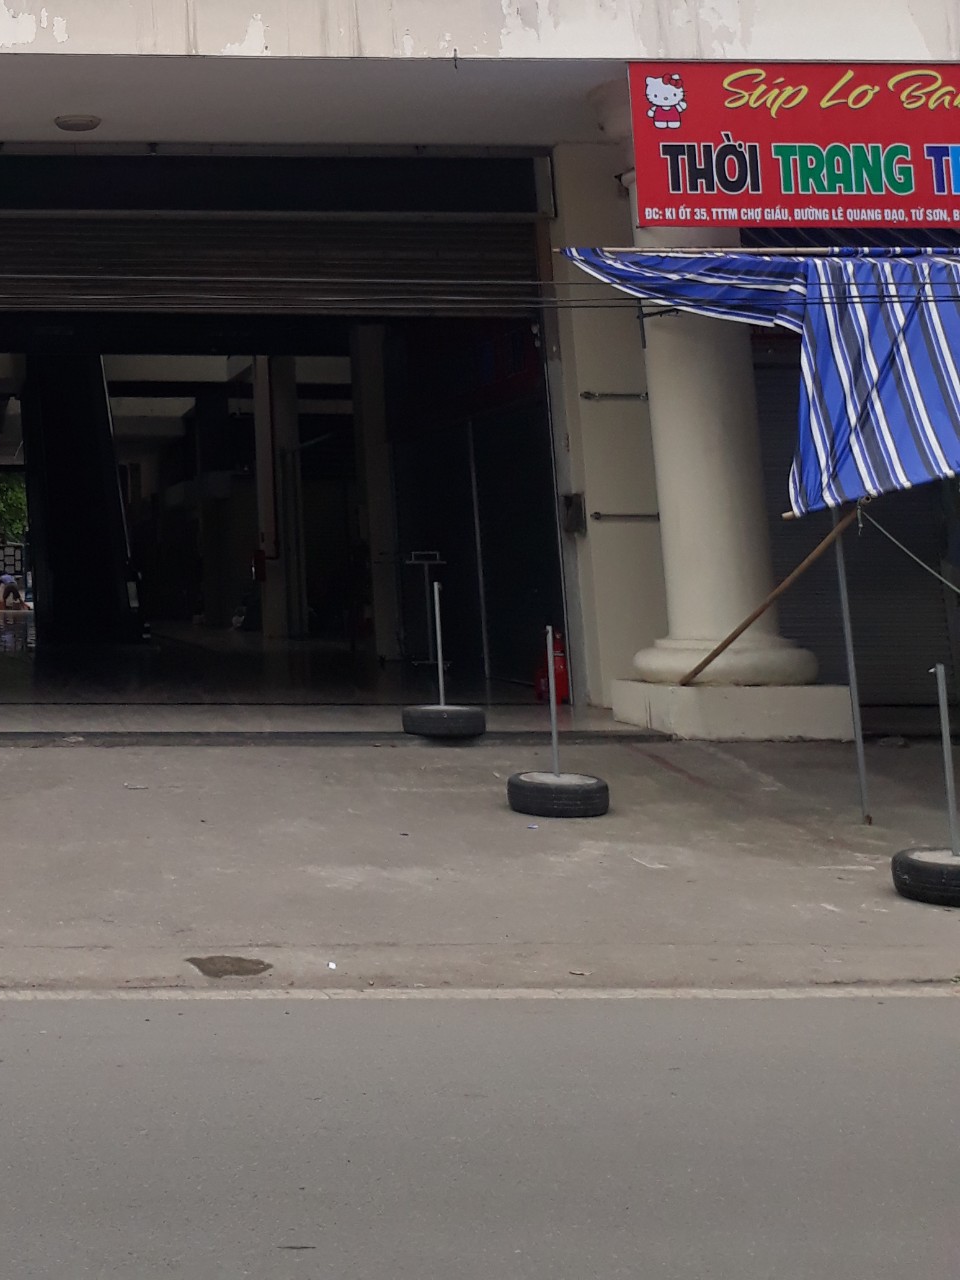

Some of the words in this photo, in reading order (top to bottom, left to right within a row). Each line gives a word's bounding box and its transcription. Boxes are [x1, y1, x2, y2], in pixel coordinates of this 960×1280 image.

[722, 68, 809, 118] Súp
[819, 69, 880, 109] Lơ
[660, 131, 762, 194] THỜI
[772, 143, 914, 195] TRANG
[644, 207, 663, 219] ĐC:
[664, 207, 677, 219] KI
[694, 207, 710, 221] 35,
[711, 207, 739, 220] TTTM
[740, 207, 763, 223] CHỢ
[793, 205, 830, 221] ĐƯỜNG
[847, 207, 883, 222] QUANG
